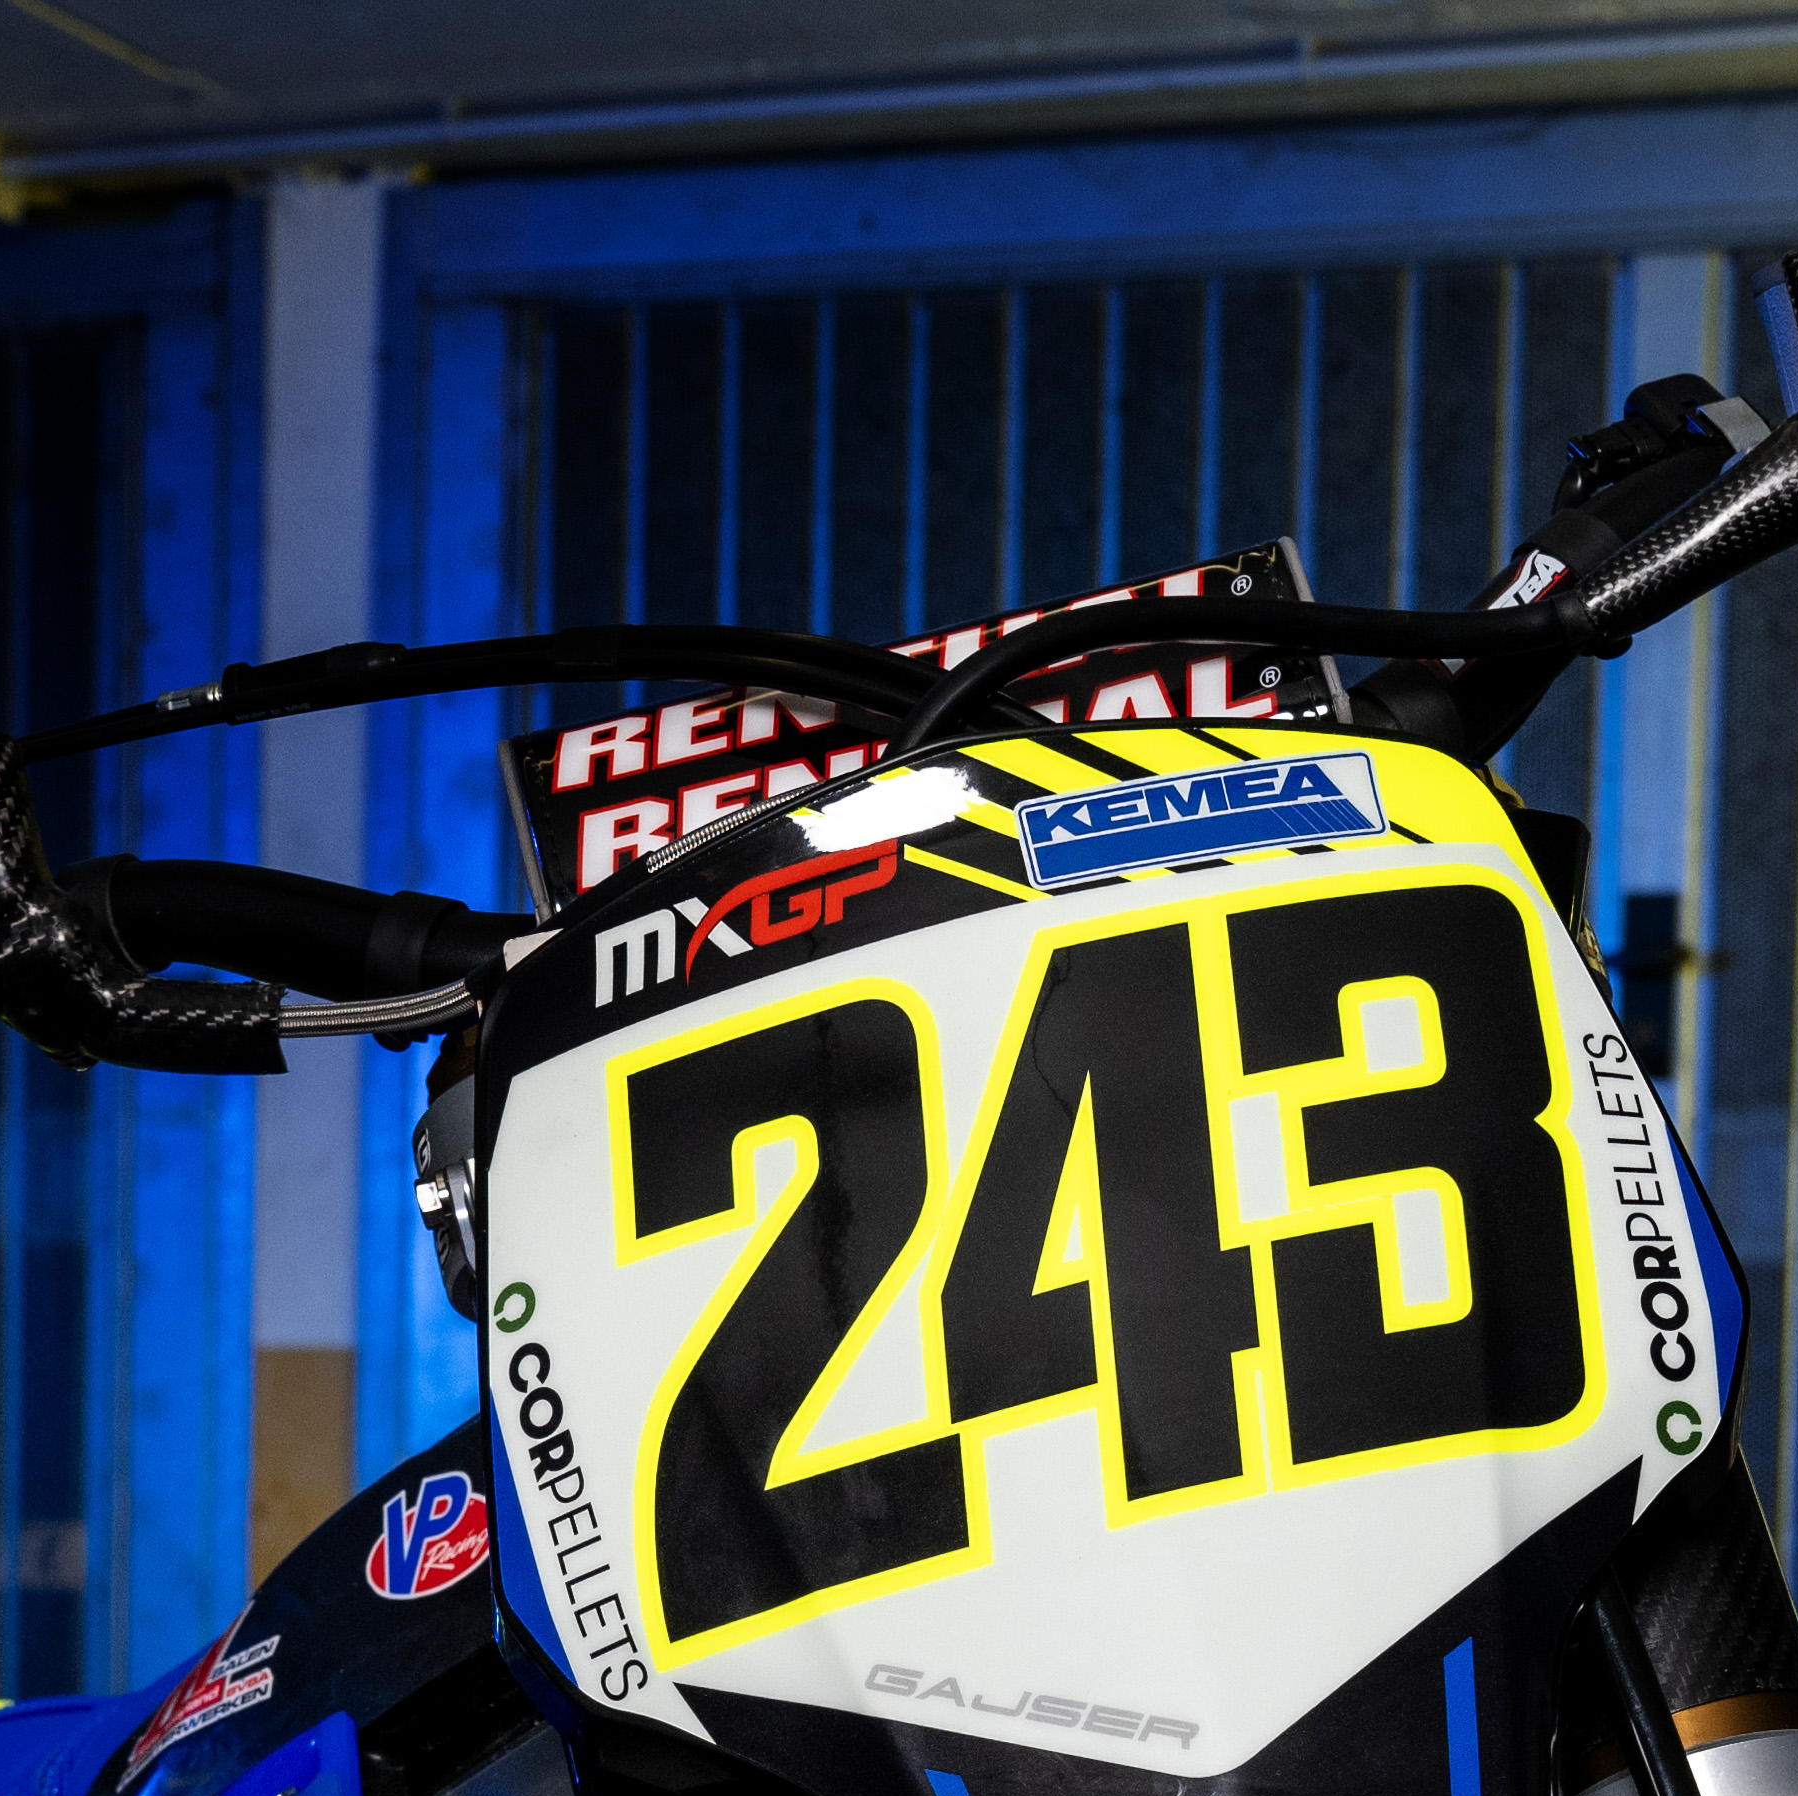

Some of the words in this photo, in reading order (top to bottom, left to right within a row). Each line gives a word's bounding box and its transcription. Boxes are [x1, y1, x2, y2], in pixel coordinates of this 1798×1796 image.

[1026, 762, 1347, 845] KEMEA
[595, 838, 899, 1008] MXGP
[615, 876, 1599, 1660] 243
[1581, 1030, 1697, 1384] CORPELLETS
[384, 1472, 471, 1597] VP
[421, 1528, 489, 1582] Racing
[507, 1341, 649, 1704] CORPELLETS
[864, 1663, 1200, 1751] GAJSER
